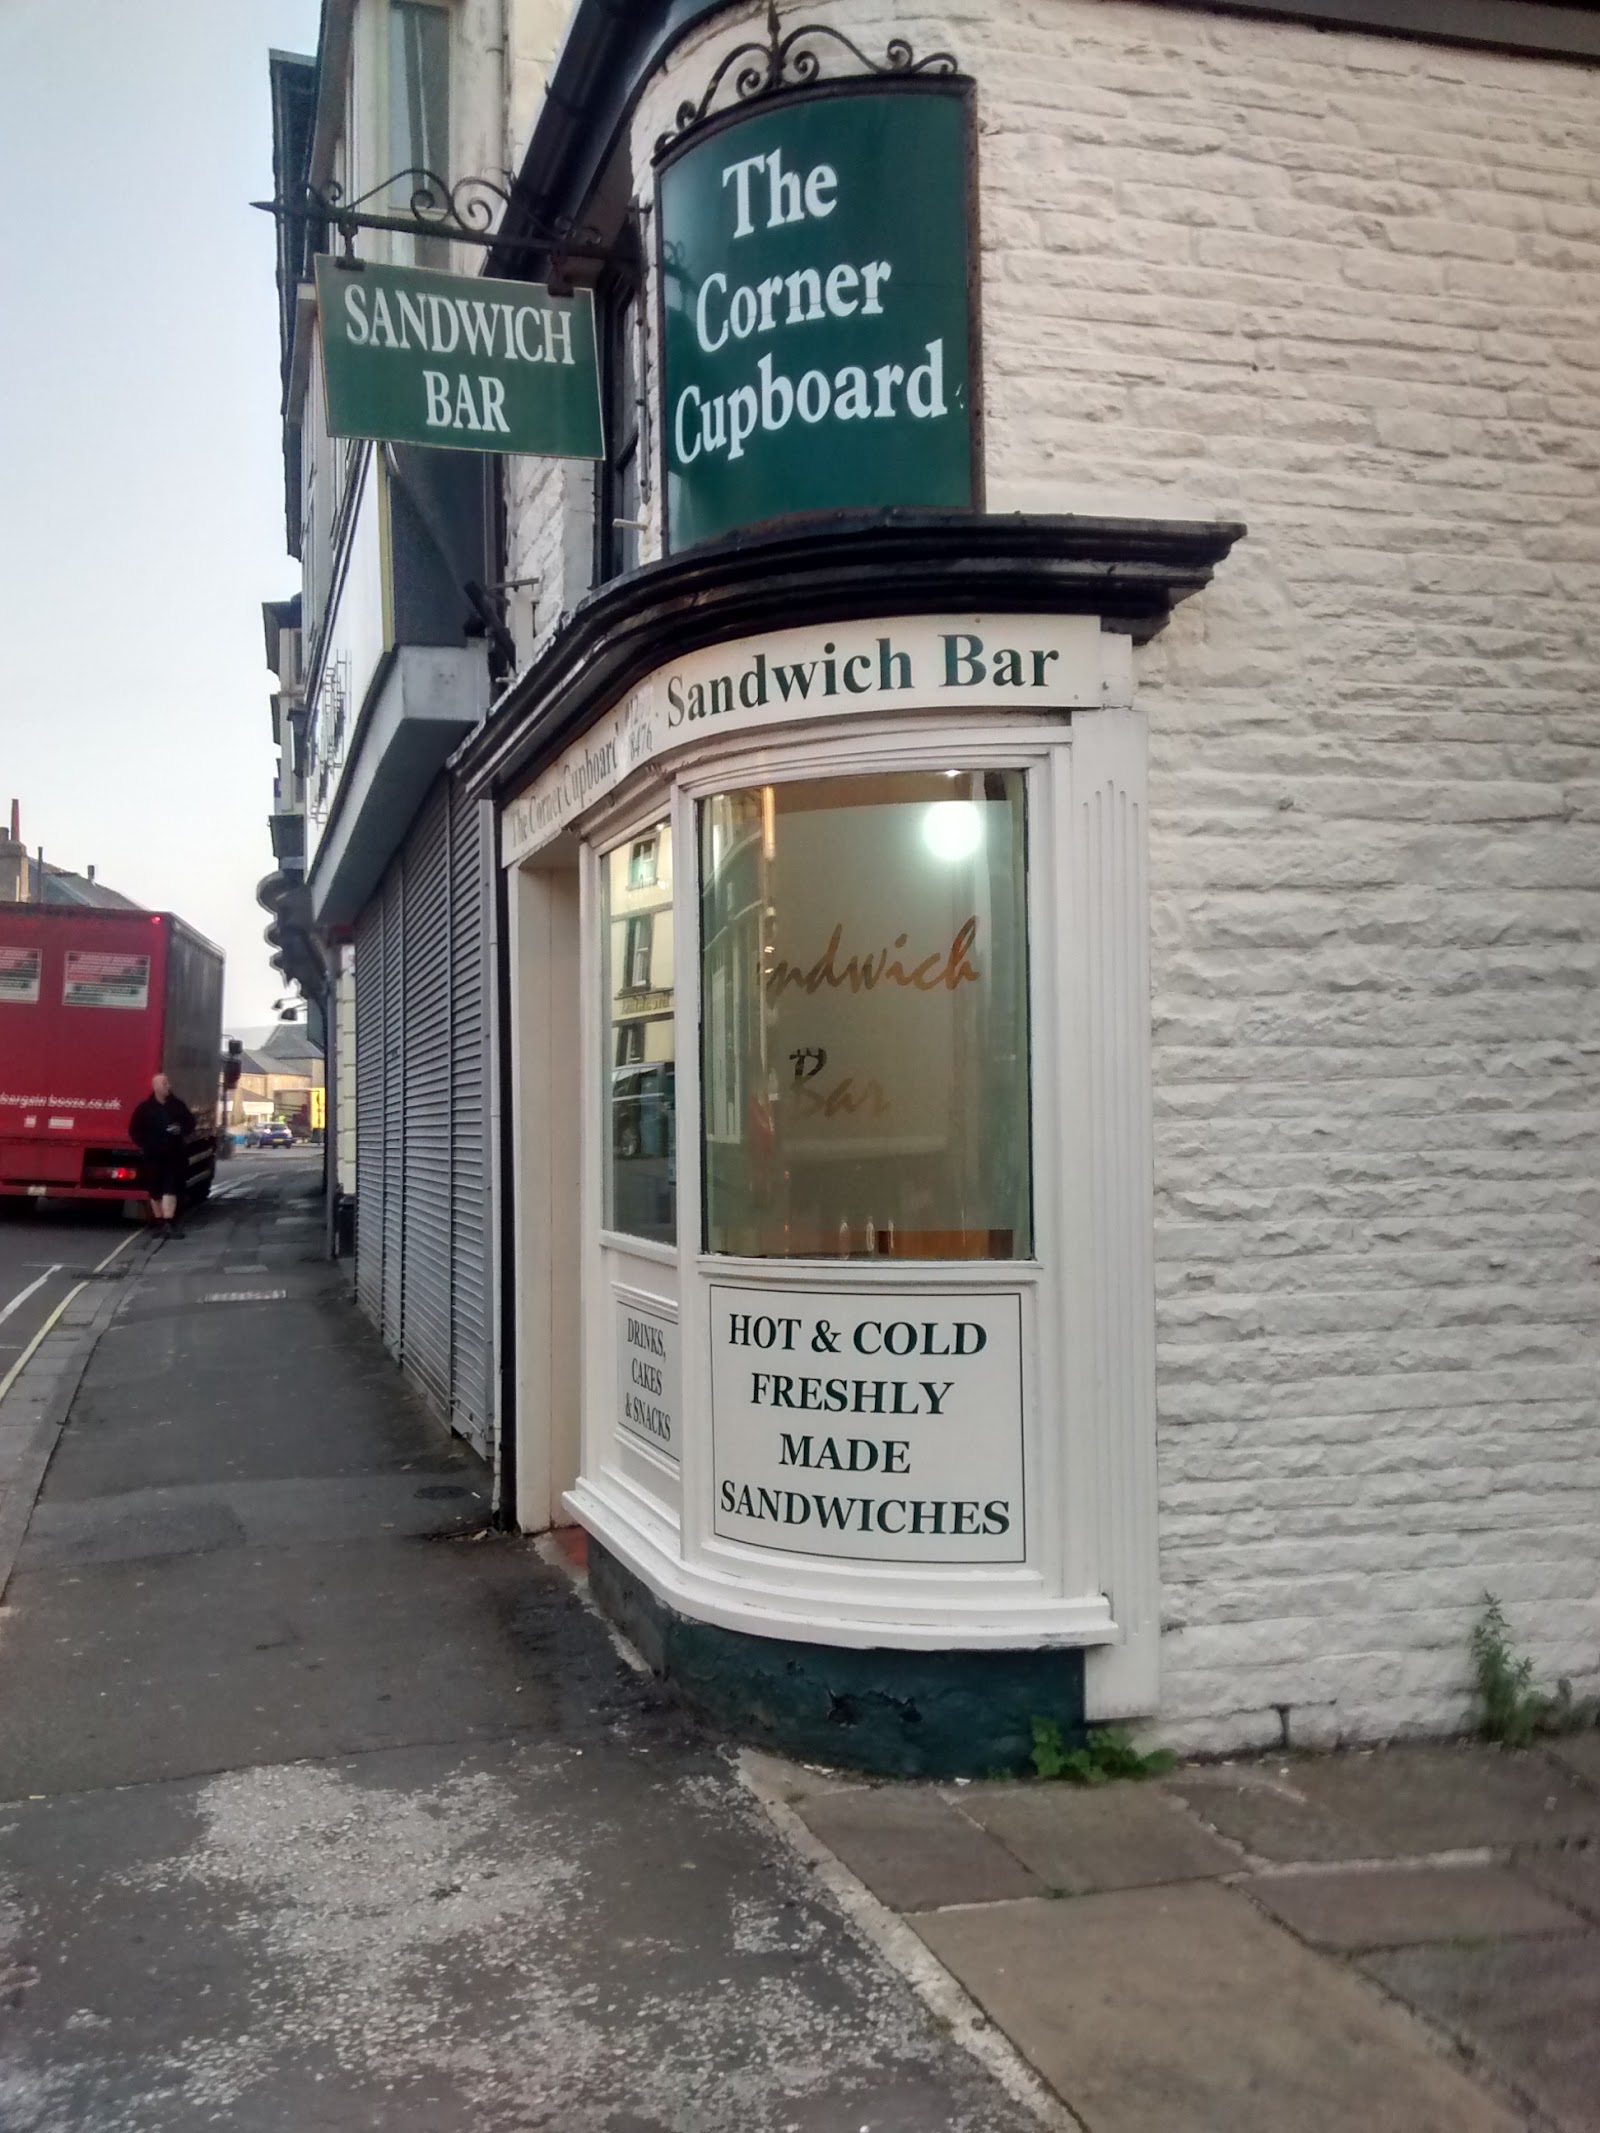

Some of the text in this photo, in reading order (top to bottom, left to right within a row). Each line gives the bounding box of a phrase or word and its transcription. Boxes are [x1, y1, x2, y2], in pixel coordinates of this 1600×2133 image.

[723, 147, 839, 239] The
[344, 284, 576, 365] SANDWICH
[697, 259, 893, 353] Corner
[423, 370, 511, 433] BAR
[675, 338, 948, 464] Cupboard
[667, 633, 1060, 729] Sandwich Bar
[511, 809, 528, 848] The
[528, 787, 562, 834] Corner
[627, 1317, 666, 1363] DRINKS,
[728, 1313, 988, 1355] HOT & COLD
[631, 1357, 663, 1396] CAKES
[750, 1372, 955, 1414] FRESHLY
[625, 1392, 671, 1442] & SNACKS
[778, 1433, 911, 1474] MADE
[720, 1480, 1010, 1535] SANDWICHES
